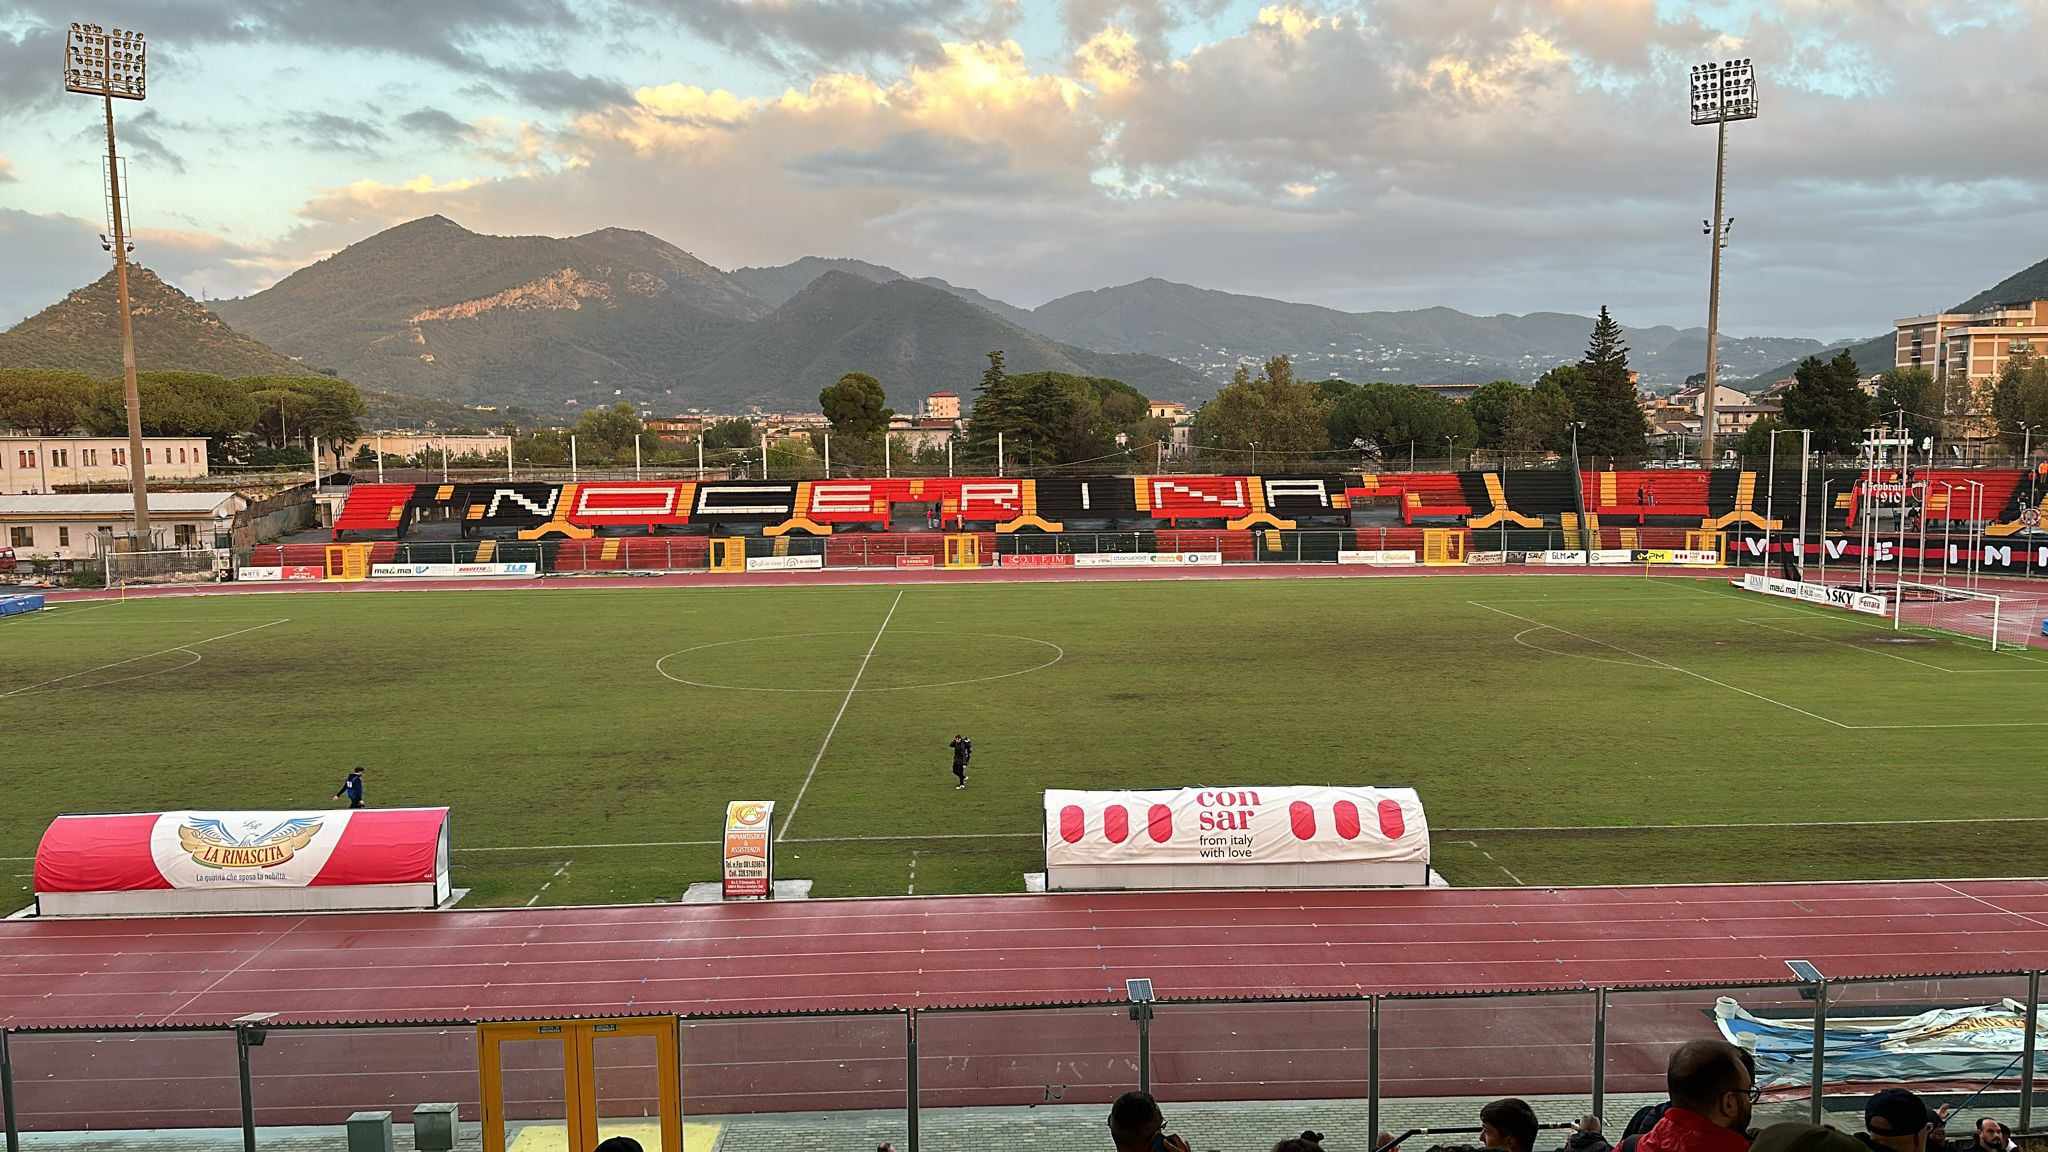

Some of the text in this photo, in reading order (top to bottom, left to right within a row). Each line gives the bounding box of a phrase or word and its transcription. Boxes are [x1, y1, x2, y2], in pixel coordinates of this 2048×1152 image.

[485, 480, 1330, 518] NOCERINA
[1745, 537, 1894, 561] VIVE
[1196, 790, 1262, 808] con
[1199, 810, 1255, 831] sar
[1200, 834, 1254, 847] from italy
[202, 845, 285, 865] LA RINASCITA
[1200, 847, 1252, 858] with love
